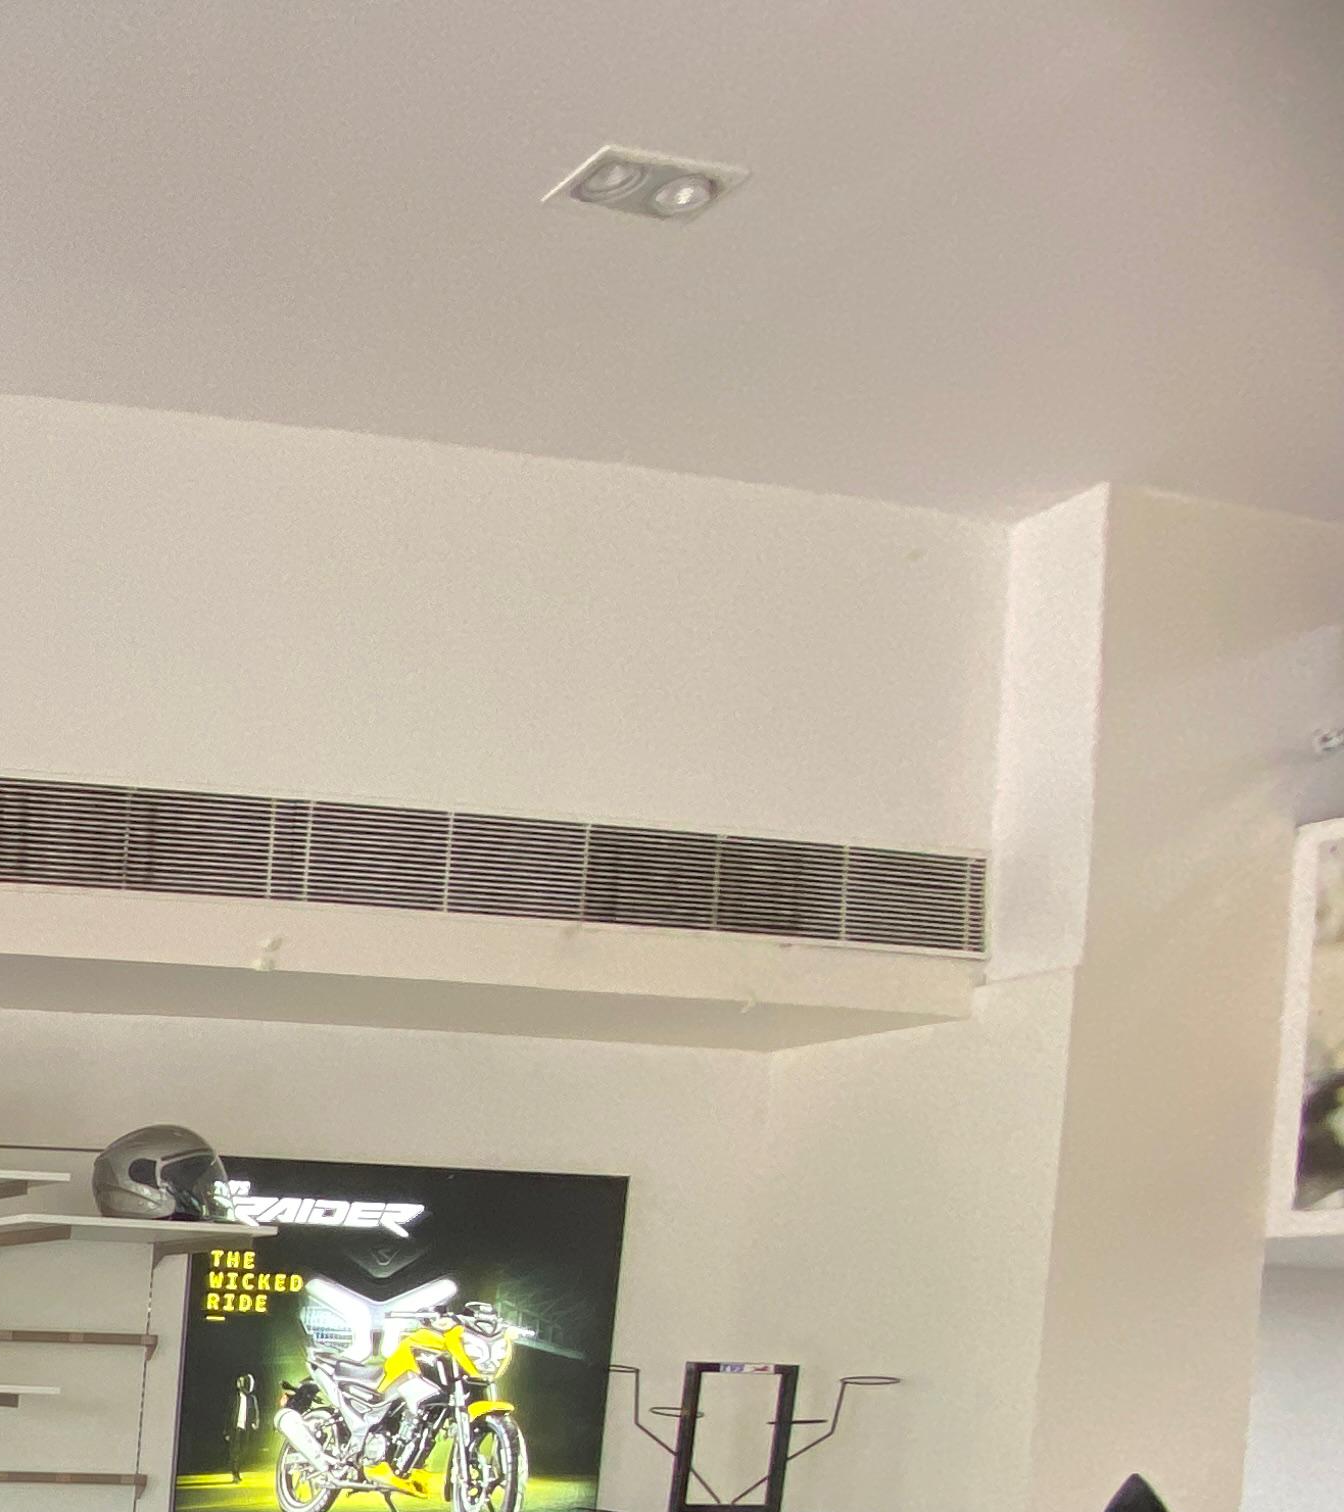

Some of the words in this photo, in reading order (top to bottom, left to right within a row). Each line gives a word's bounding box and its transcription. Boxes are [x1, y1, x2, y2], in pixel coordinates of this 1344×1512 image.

[214, 1195, 425, 1239] RAIDER
[210, 1249, 257, 1270] THE
[208, 1271, 305, 1293] WICKED
[206, 1292, 268, 1313] RIDE
